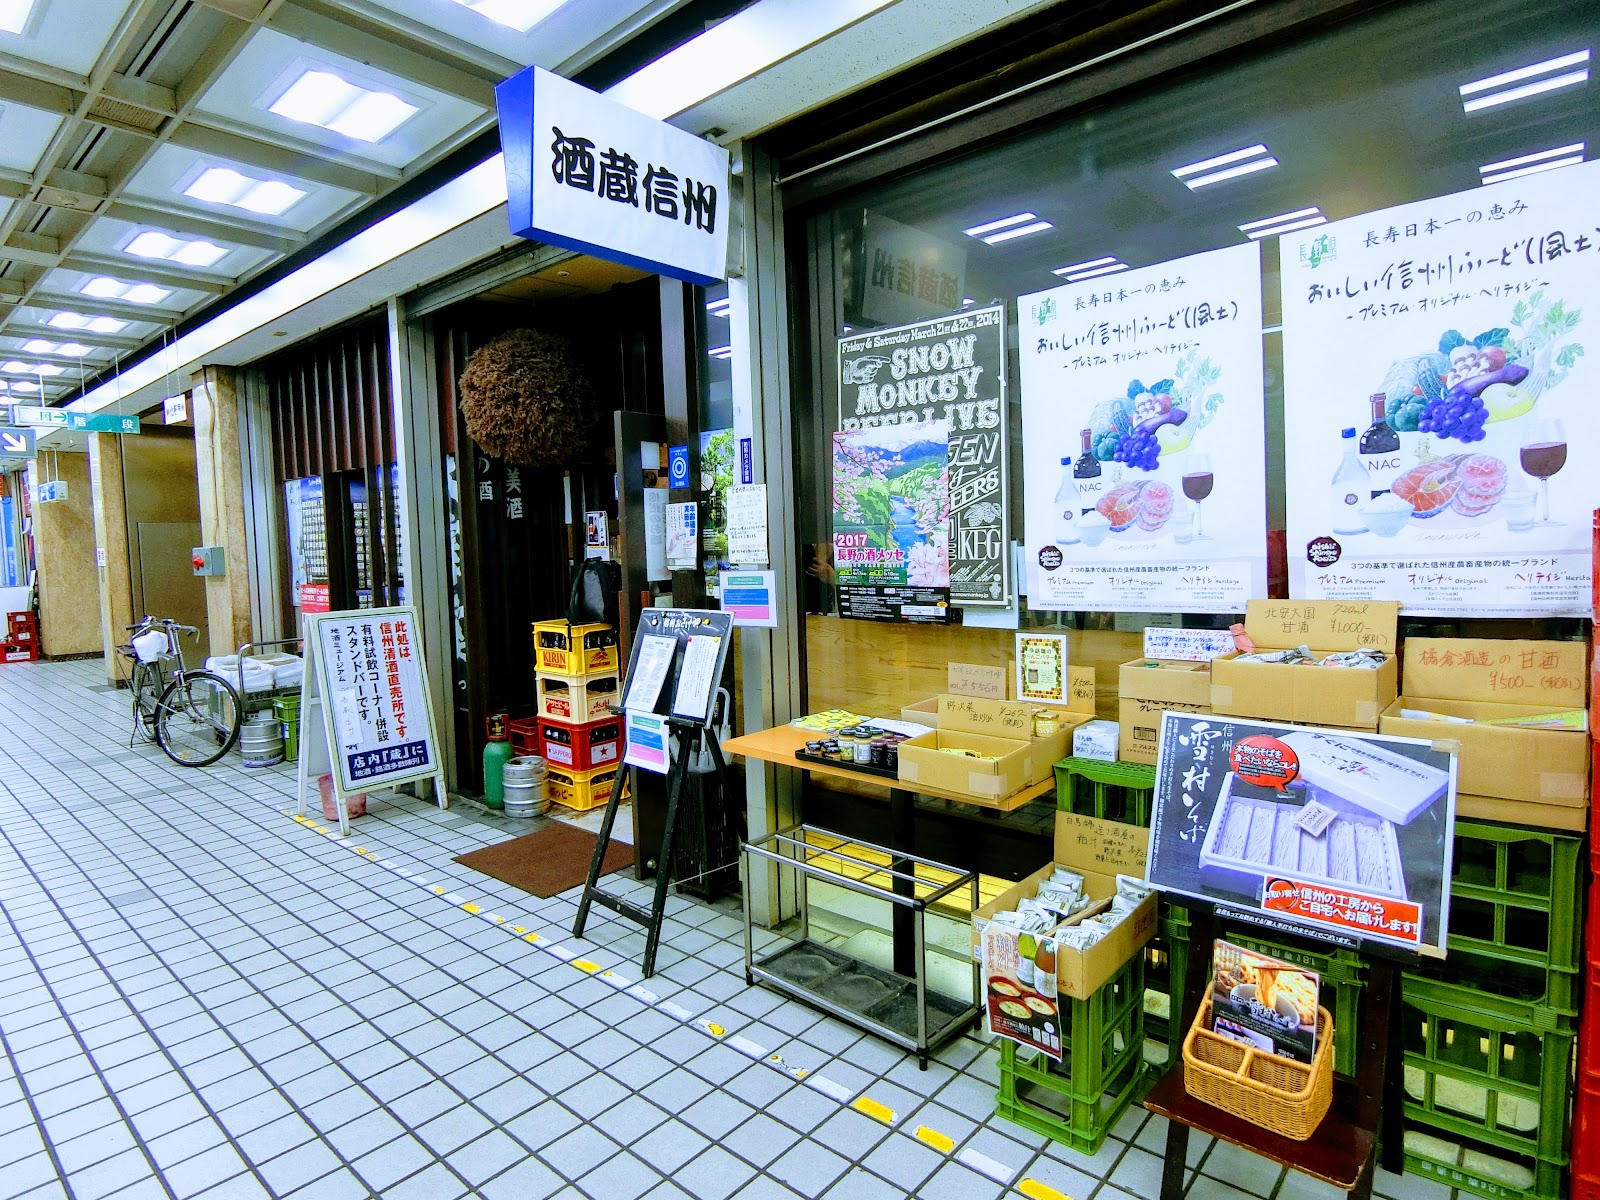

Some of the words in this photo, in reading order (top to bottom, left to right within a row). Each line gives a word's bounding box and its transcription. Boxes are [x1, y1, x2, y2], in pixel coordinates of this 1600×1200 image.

[551, 126, 717, 234] 酒蔵信州
[1363, 199, 1528, 248] 長寿日本一の恵み
[1073, 276, 1186, 311] 長寿日本一の恵み
[841, 341, 865, 354] Friday
[866, 337, 873, 348] &
[874, 332, 911, 348] Saturday
[911, 327, 937, 340] March
[951, 321, 959, 333] &
[977, 312, 999, 327] 2014
[890, 334, 977, 380] SNOW
[855, 366, 984, 415] MONKEY
[73, 416, 134, 430] 階段
[505, 467, 523, 520] 美酒
[837, 532, 868, 547] 2017
[837, 549, 905, 562] 長野の酒メッセ
[960, 529, 1002, 560] KEG
[1317, 574, 1353, 586] プレミアム
[1408, 573, 1453, 586] オリジナル
[1455, 577, 1488, 585] Original
[330, 628, 346, 682] 地酒ミュージアム
[394, 621, 412, 664] 此処は、
[543, 651, 566, 664] KIRIN
[346, 625, 372, 725] スタンドバーです。
[361, 624, 389, 743] 有料試飲コーナー併設
[379, 622, 410, 743] 信州清酒直売所です。
[546, 698, 570, 711] アサヒビール
[551, 747, 572, 759] SAPPORO
[1221, 723, 1235, 753] 信州
[1234, 744, 1283, 759] 本物のそばを
[1300, 886, 1384, 915] 信州の工房から
